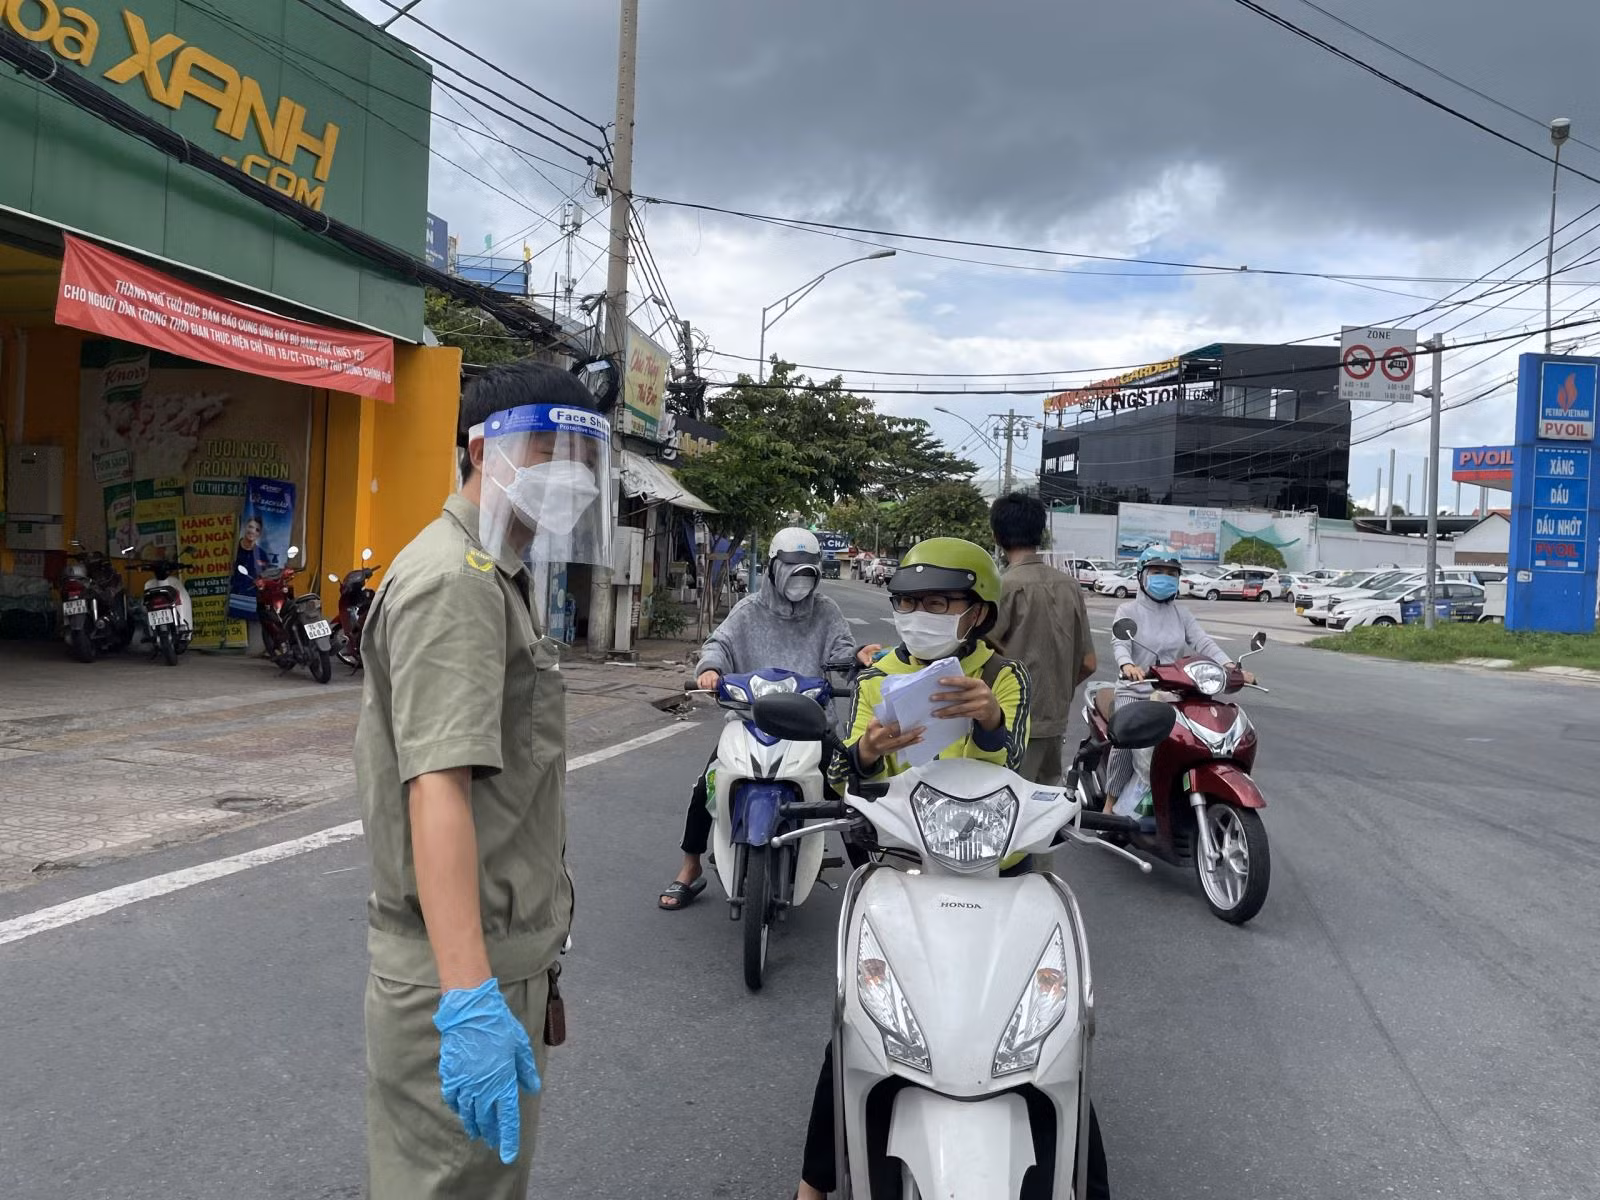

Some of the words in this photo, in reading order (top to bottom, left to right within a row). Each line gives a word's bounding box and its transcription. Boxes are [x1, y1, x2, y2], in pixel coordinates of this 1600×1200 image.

[0, 0, 99, 67] oa
[103, 8, 341, 183] XANH
[116, 280, 147, 301] THÀNH
[147, 291, 165, 307] PHỐ
[166, 296, 182, 313] THỦ
[238, 318, 258, 334] CUNG
[64, 284, 86, 302] CHO
[88, 290, 116, 312] NGƯỜI
[138, 306, 167, 327] TRONG
[169, 316, 189, 334] THỜI
[190, 322, 210, 339] GIAN
[231, 334, 250, 352] HIỆN
[1367, 330, 1392, 340] ZONE
[104, 366, 146, 386] Knorr
[1119, 357, 1180, 385] GARDEN
[556, 410, 586, 424] Face
[1460, 450, 1514, 466] PVOIL
[1550, 456, 1575, 476] XĂNG
[182, 516, 215, 530] HÀNG
